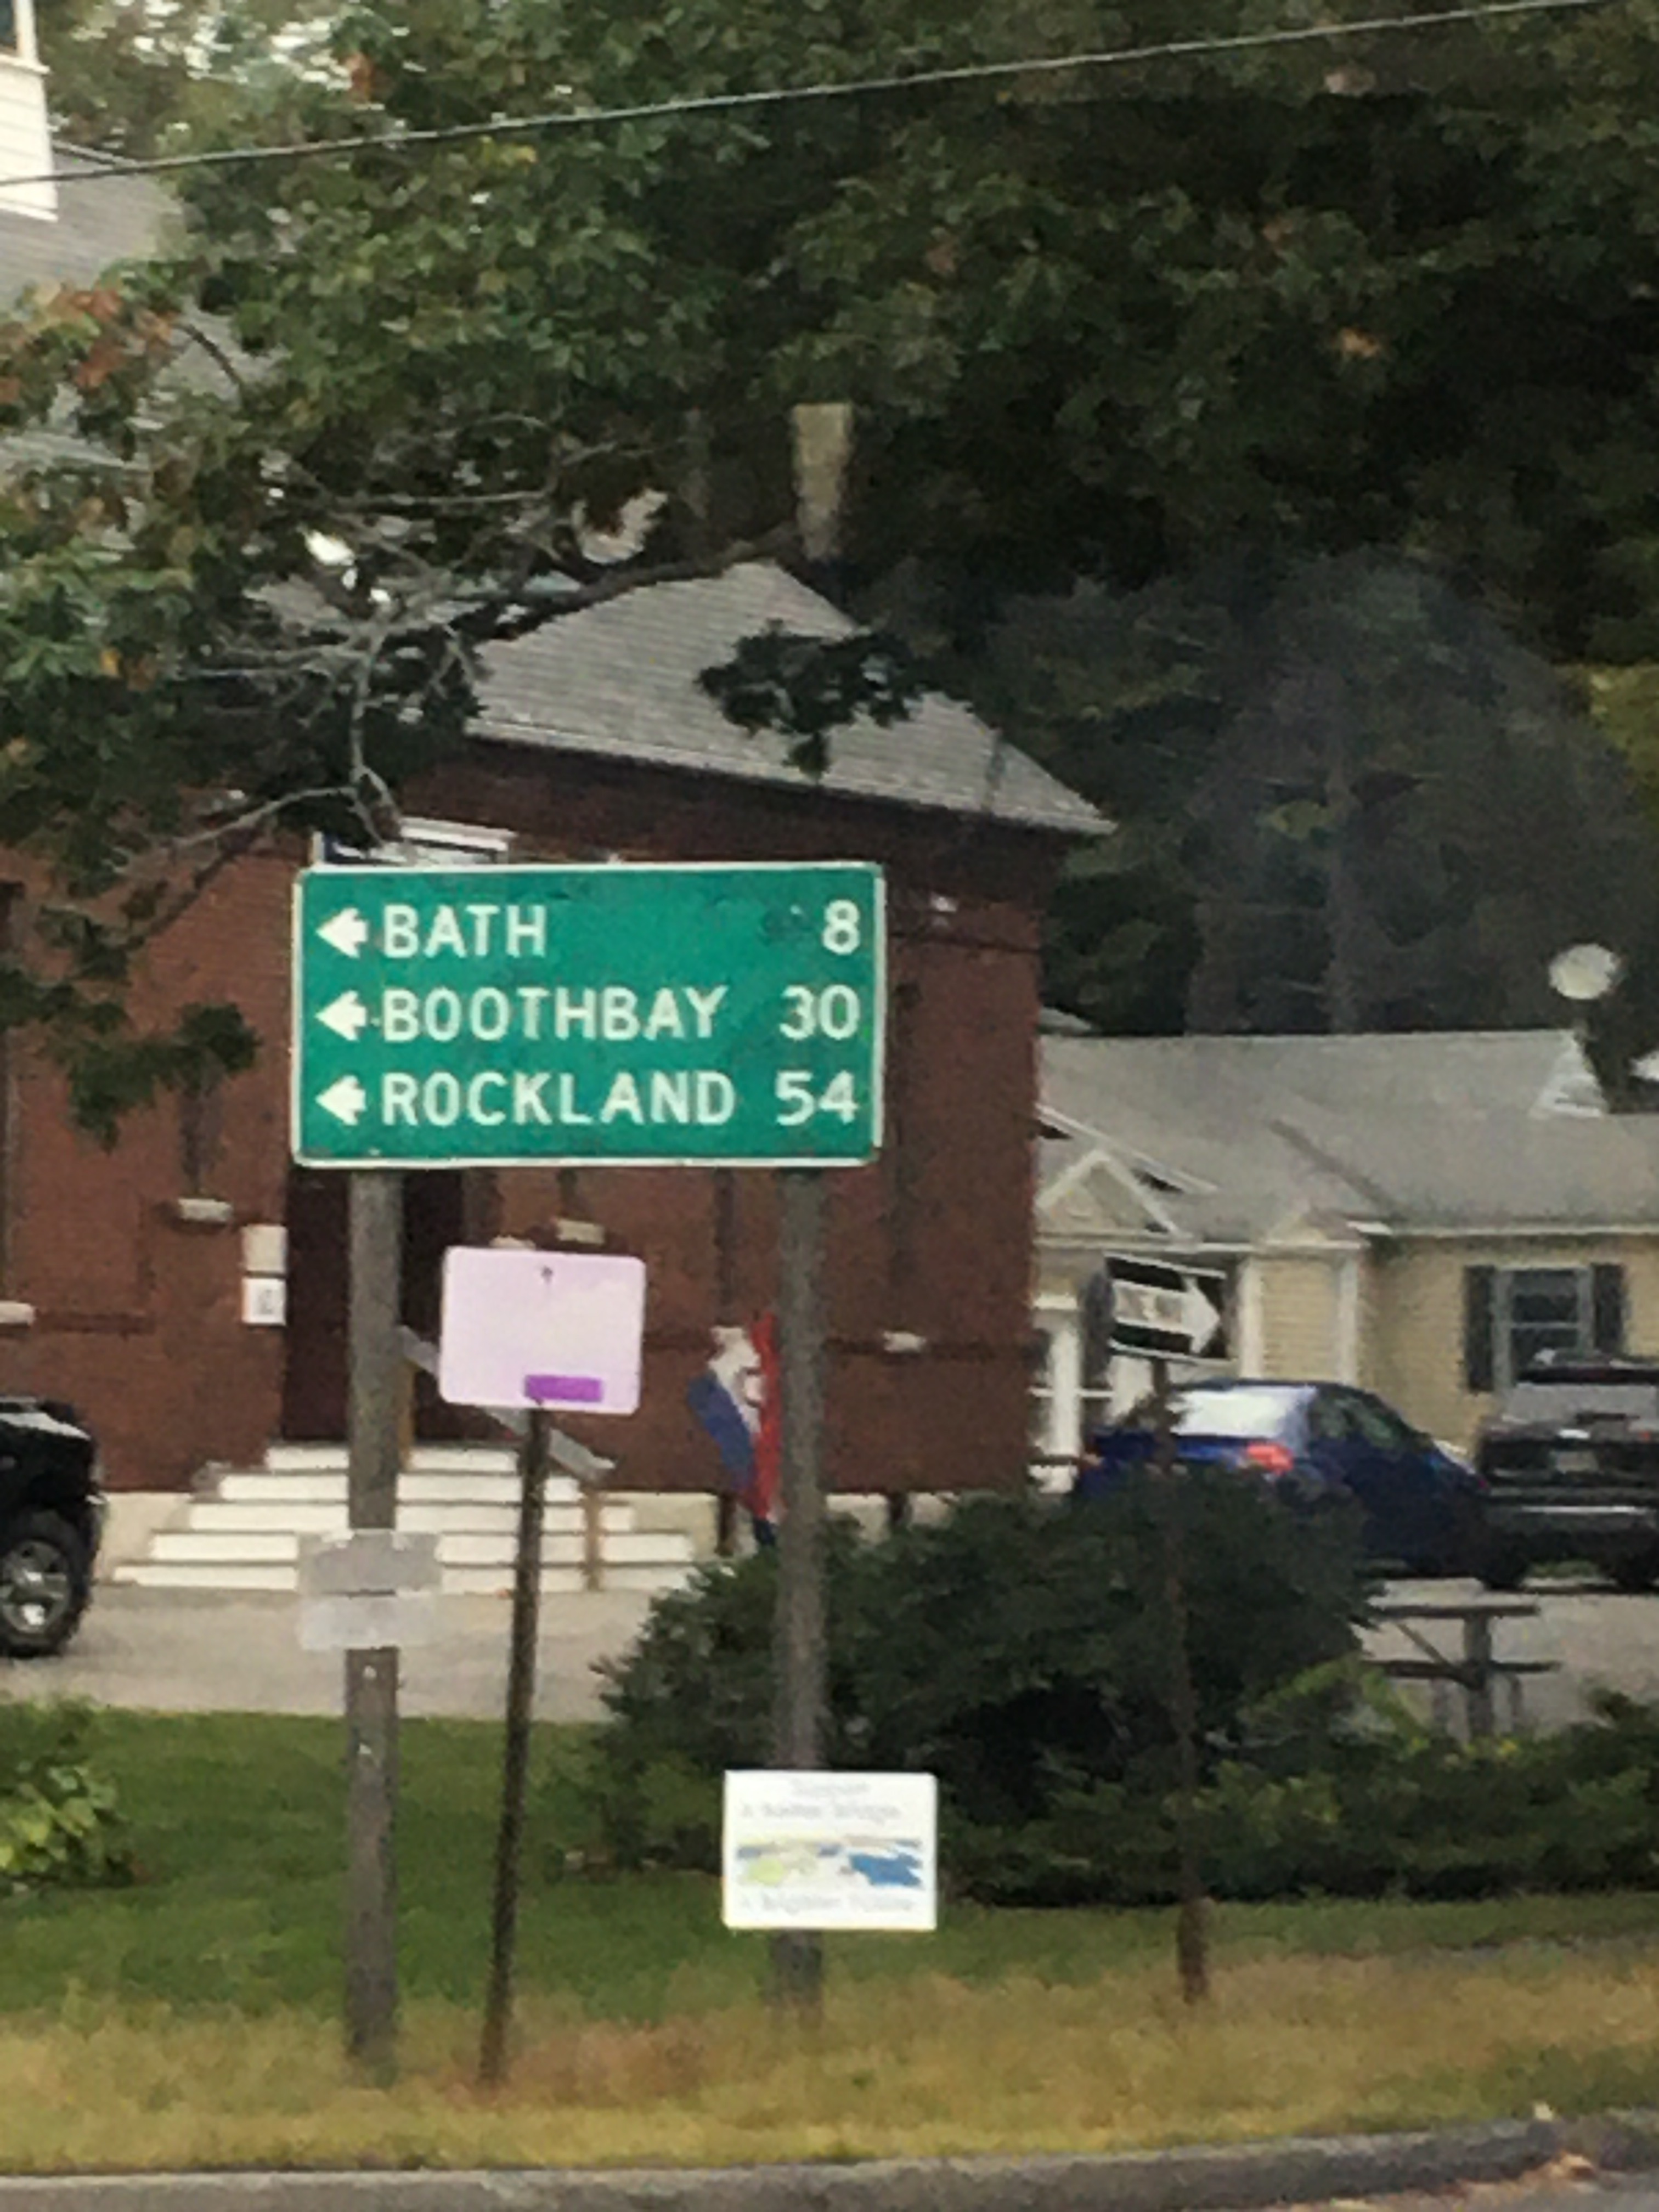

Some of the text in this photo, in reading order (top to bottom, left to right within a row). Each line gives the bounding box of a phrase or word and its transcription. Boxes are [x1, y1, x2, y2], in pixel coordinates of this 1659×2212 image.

[382, 900, 860, 958] BATH 8
[382, 985, 860, 1042] BOOTHBAY 30
[382, 1071, 859, 1126] ROCKLAND 54
